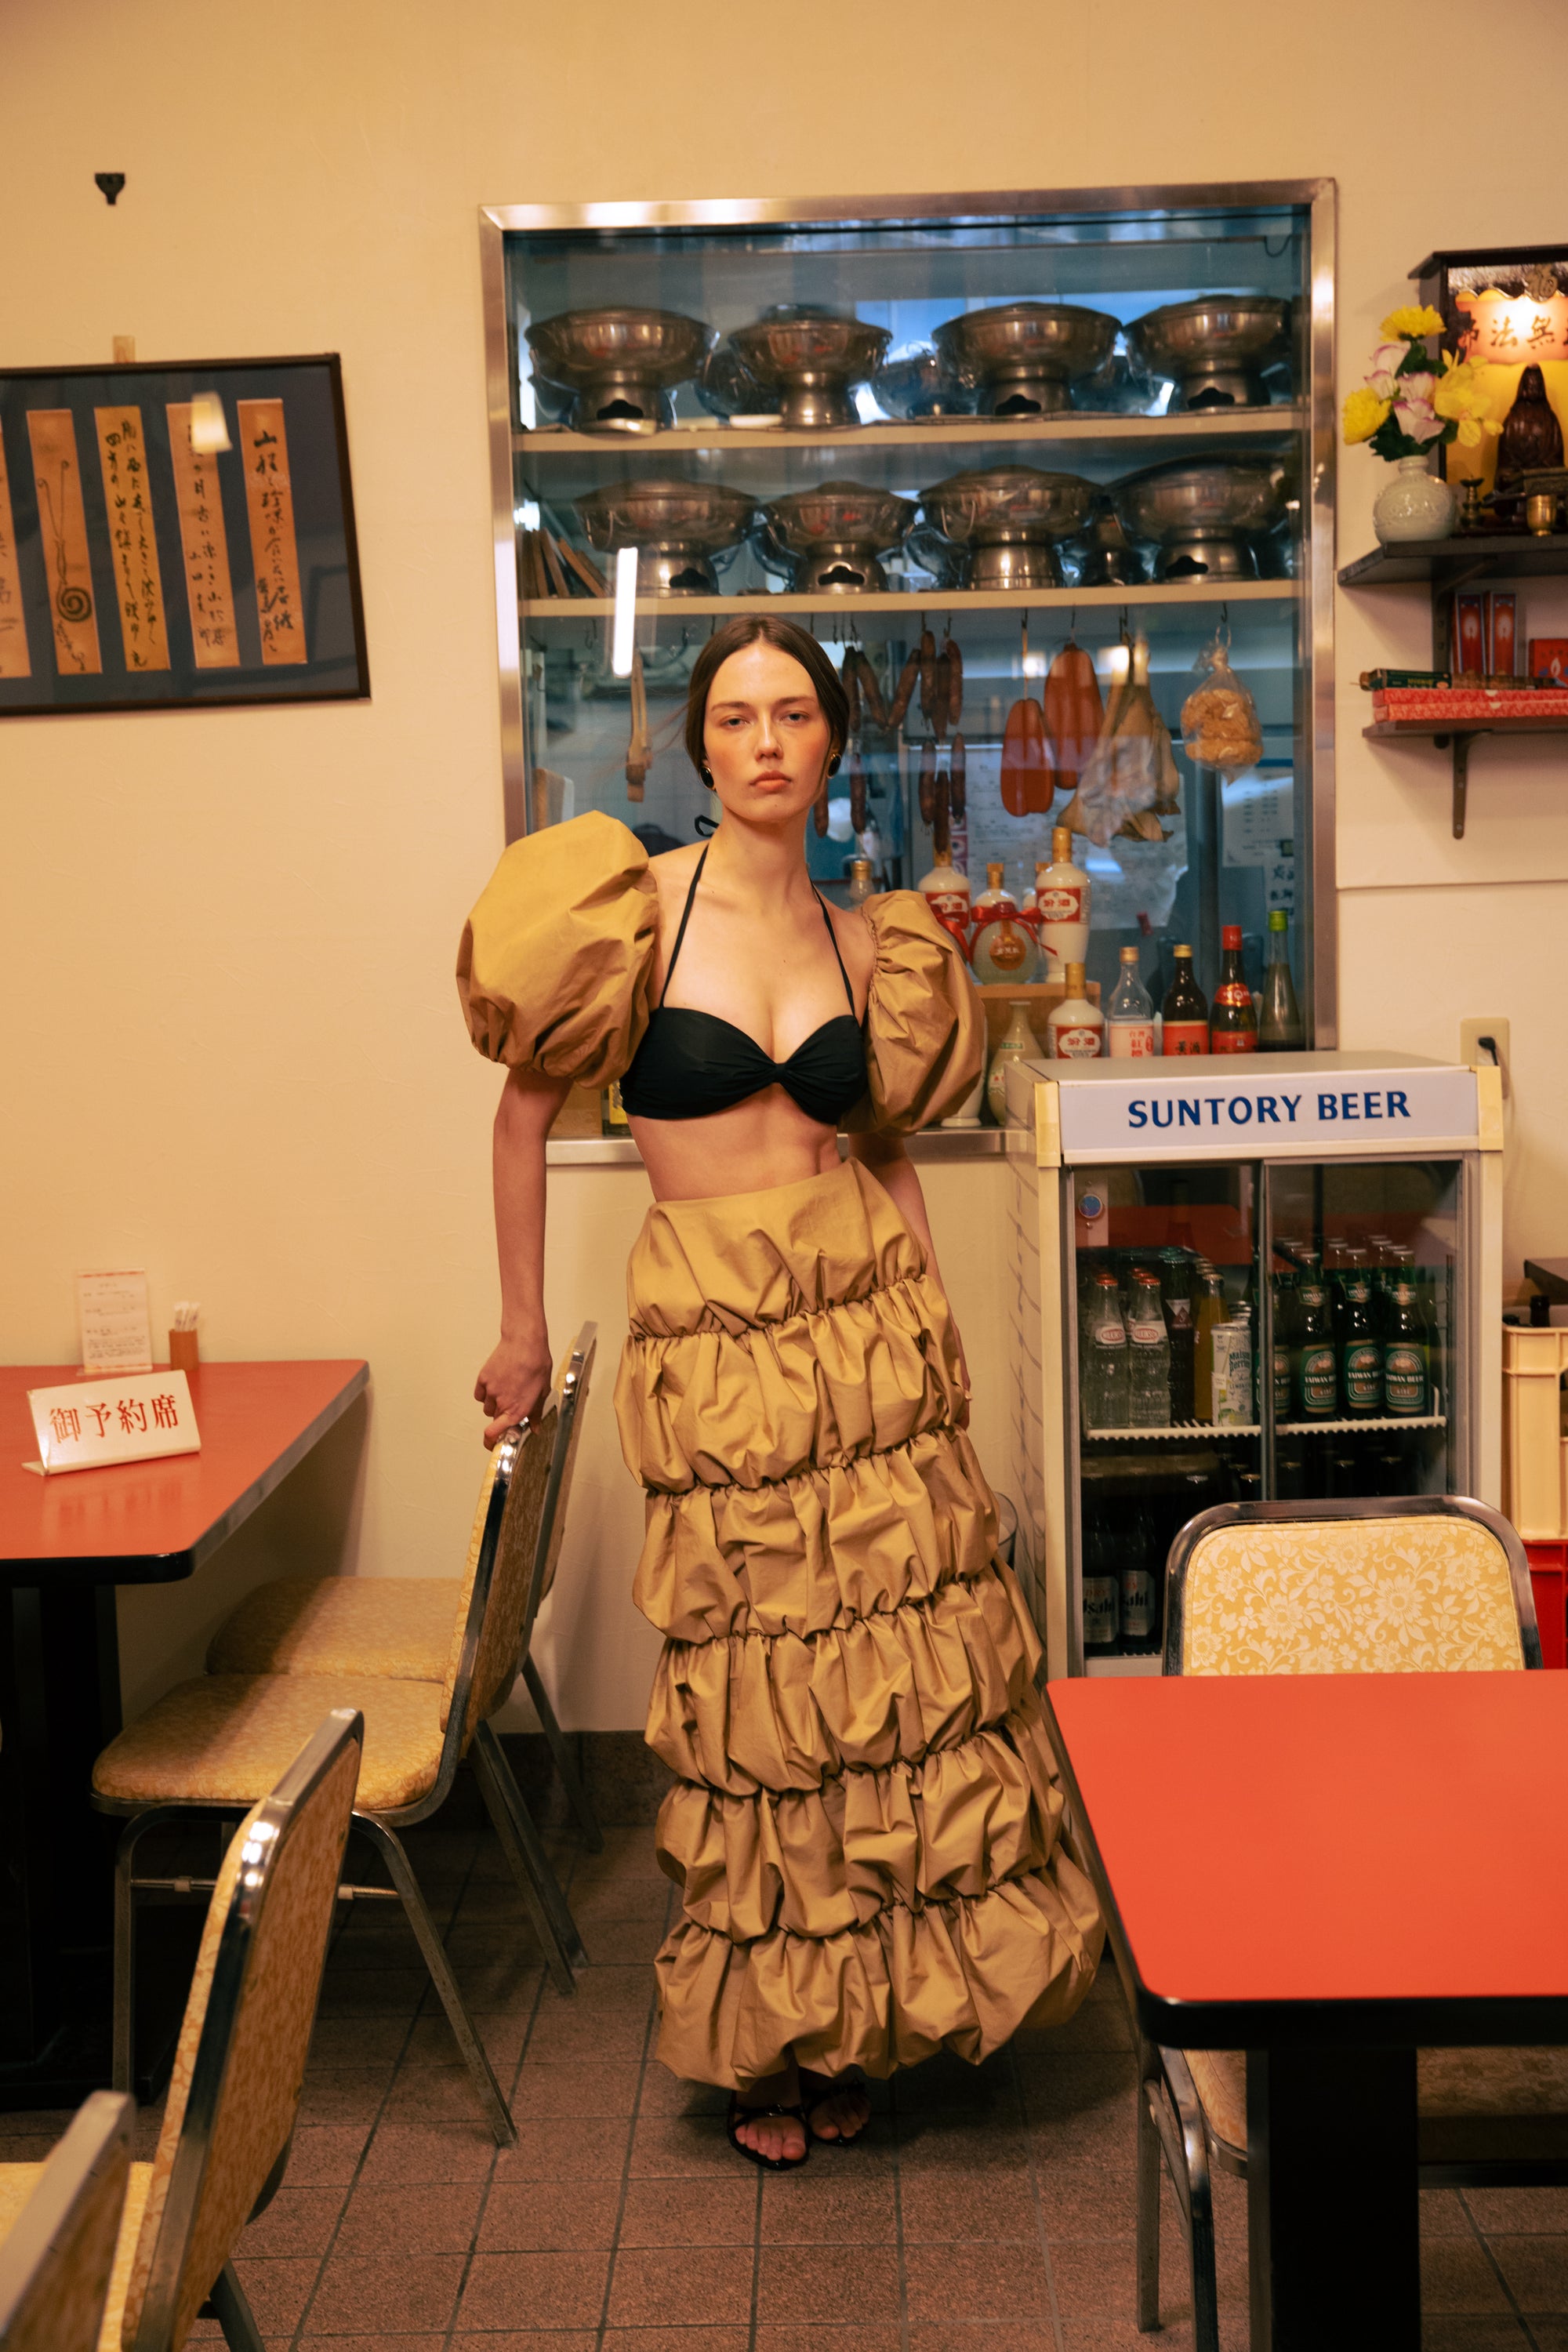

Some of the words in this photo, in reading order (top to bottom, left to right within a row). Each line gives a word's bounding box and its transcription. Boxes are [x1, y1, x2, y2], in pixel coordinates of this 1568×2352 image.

[1128, 1094, 1302, 1128] SUNTORY
[1317, 1091, 1411, 1121] BEER
[49, 1394, 179, 1443] 御予約席
